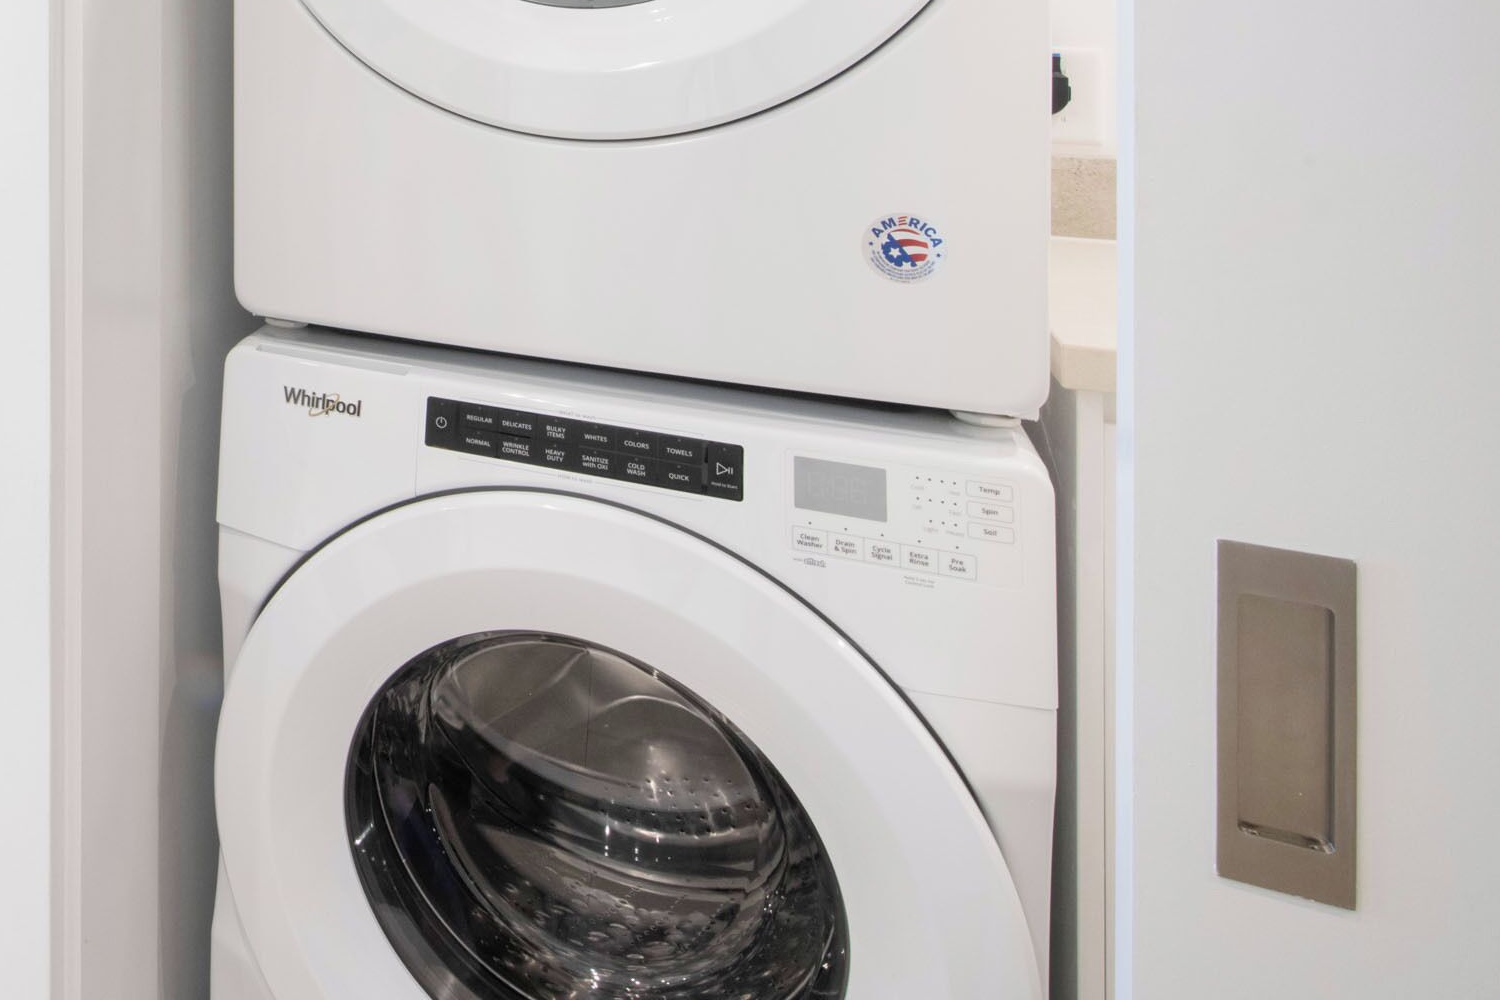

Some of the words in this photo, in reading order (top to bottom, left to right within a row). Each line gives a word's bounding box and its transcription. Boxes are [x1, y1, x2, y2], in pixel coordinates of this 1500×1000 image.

[871, 216, 943, 248] AMERICA
[283, 385, 362, 417] Whirlpool
[466, 414, 493, 424] REGULAR
[502, 420, 532, 430] DELICATES
[546, 425, 566, 433] BULKY
[546, 431, 565, 439] ITEMS
[584, 433, 608, 443] WHITES
[465, 437, 491, 447] NORMAL
[502, 441, 529, 451] WRINKLE
[624, 440, 650, 450] COLORS
[501, 446, 530, 457] CONTROL
[545, 448, 565, 457] HEAVY
[666, 447, 693, 457] TOWELS
[546, 455, 564, 463] DUTY
[581, 454, 609, 465] SANITIZE
[582, 461, 597, 469] with
[627, 462, 645, 471] COLD
[626, 468, 646, 477] WASH
[668, 472, 690, 482] QUICK
[979, 486, 1001, 496] Temp
[981, 507, 999, 516] Spin
[983, 528, 998, 536] Soil
[800, 533, 820, 542] Clean
[796, 539, 823, 549] Washer
[835, 539, 855, 548] Drain
[841, 546, 857, 555] Spin
[872, 545, 892, 554] Cycle
[871, 551, 893, 561] Signal
[909, 551, 929, 560] Extra
[909, 558, 930, 567] Rinse
[948, 564, 967, 573] Soak
